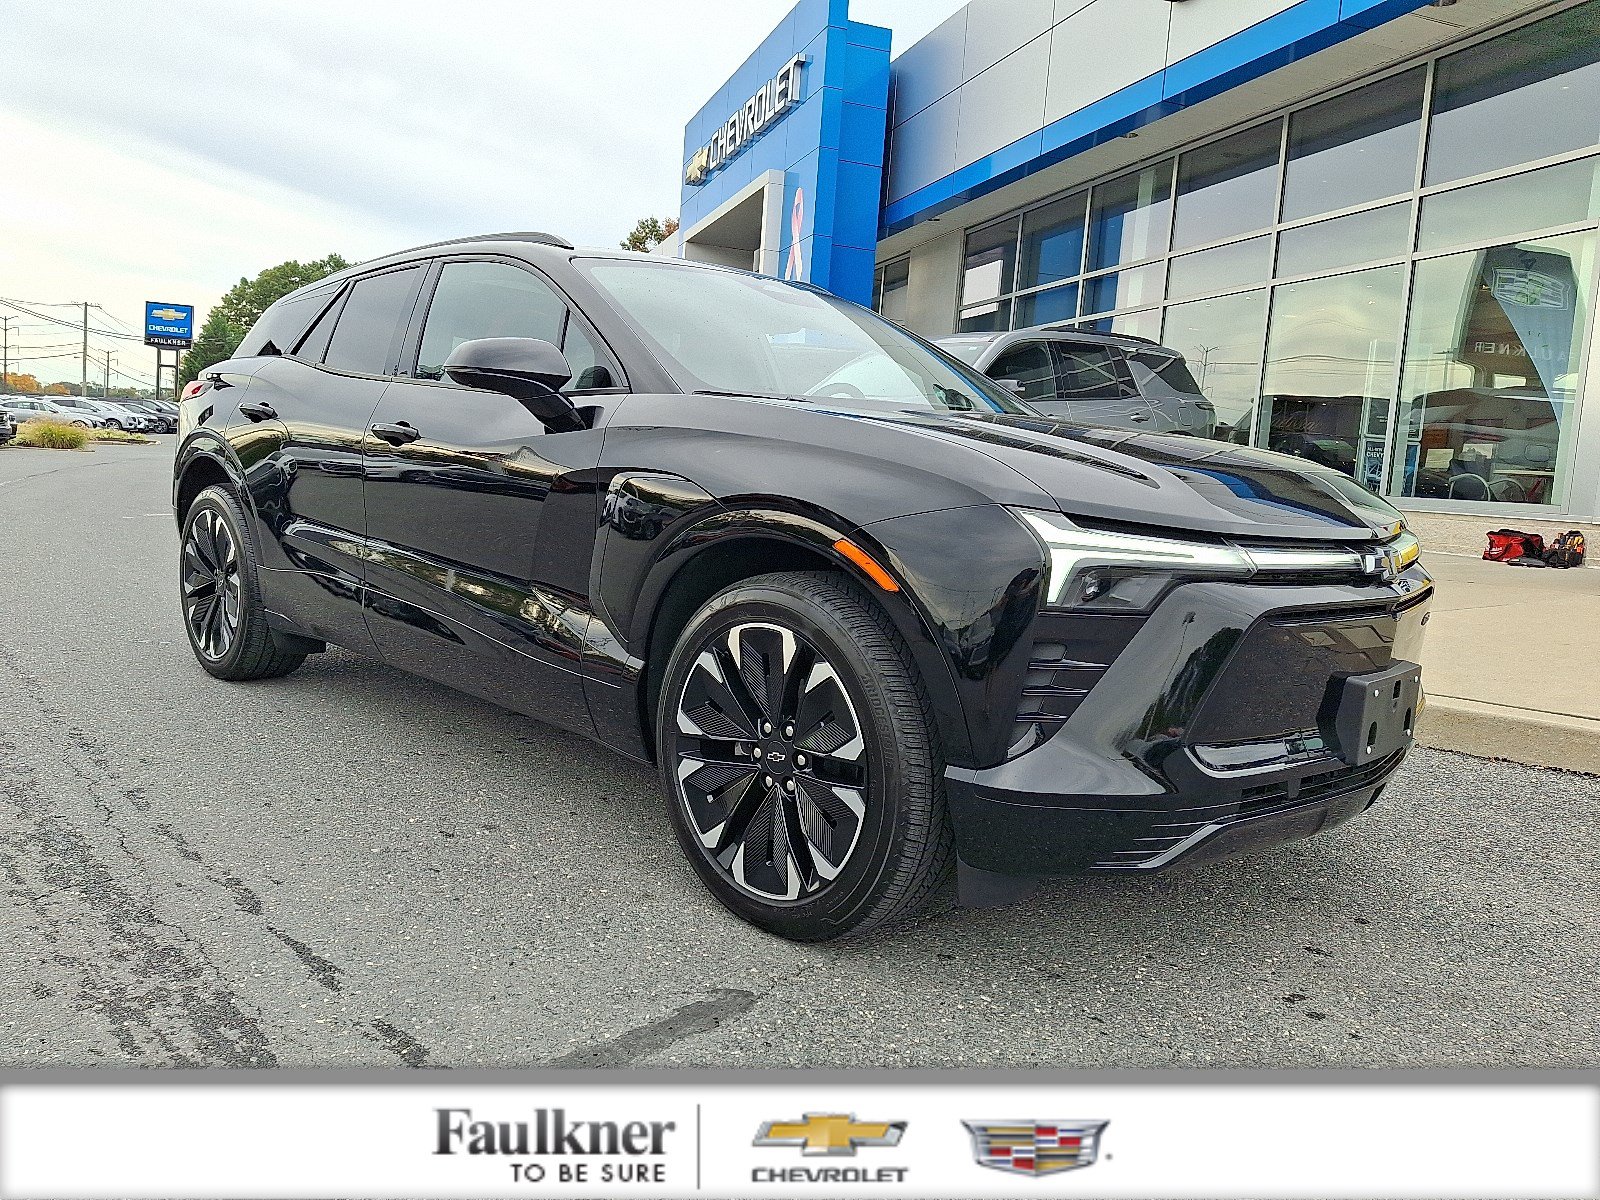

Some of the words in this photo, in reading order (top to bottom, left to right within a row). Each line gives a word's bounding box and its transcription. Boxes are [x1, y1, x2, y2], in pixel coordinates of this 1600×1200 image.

[709, 52, 808, 170] CHEVROLET
[148, 324, 188, 334] CHEVROLET
[150, 337, 186, 346] FAULKNER
